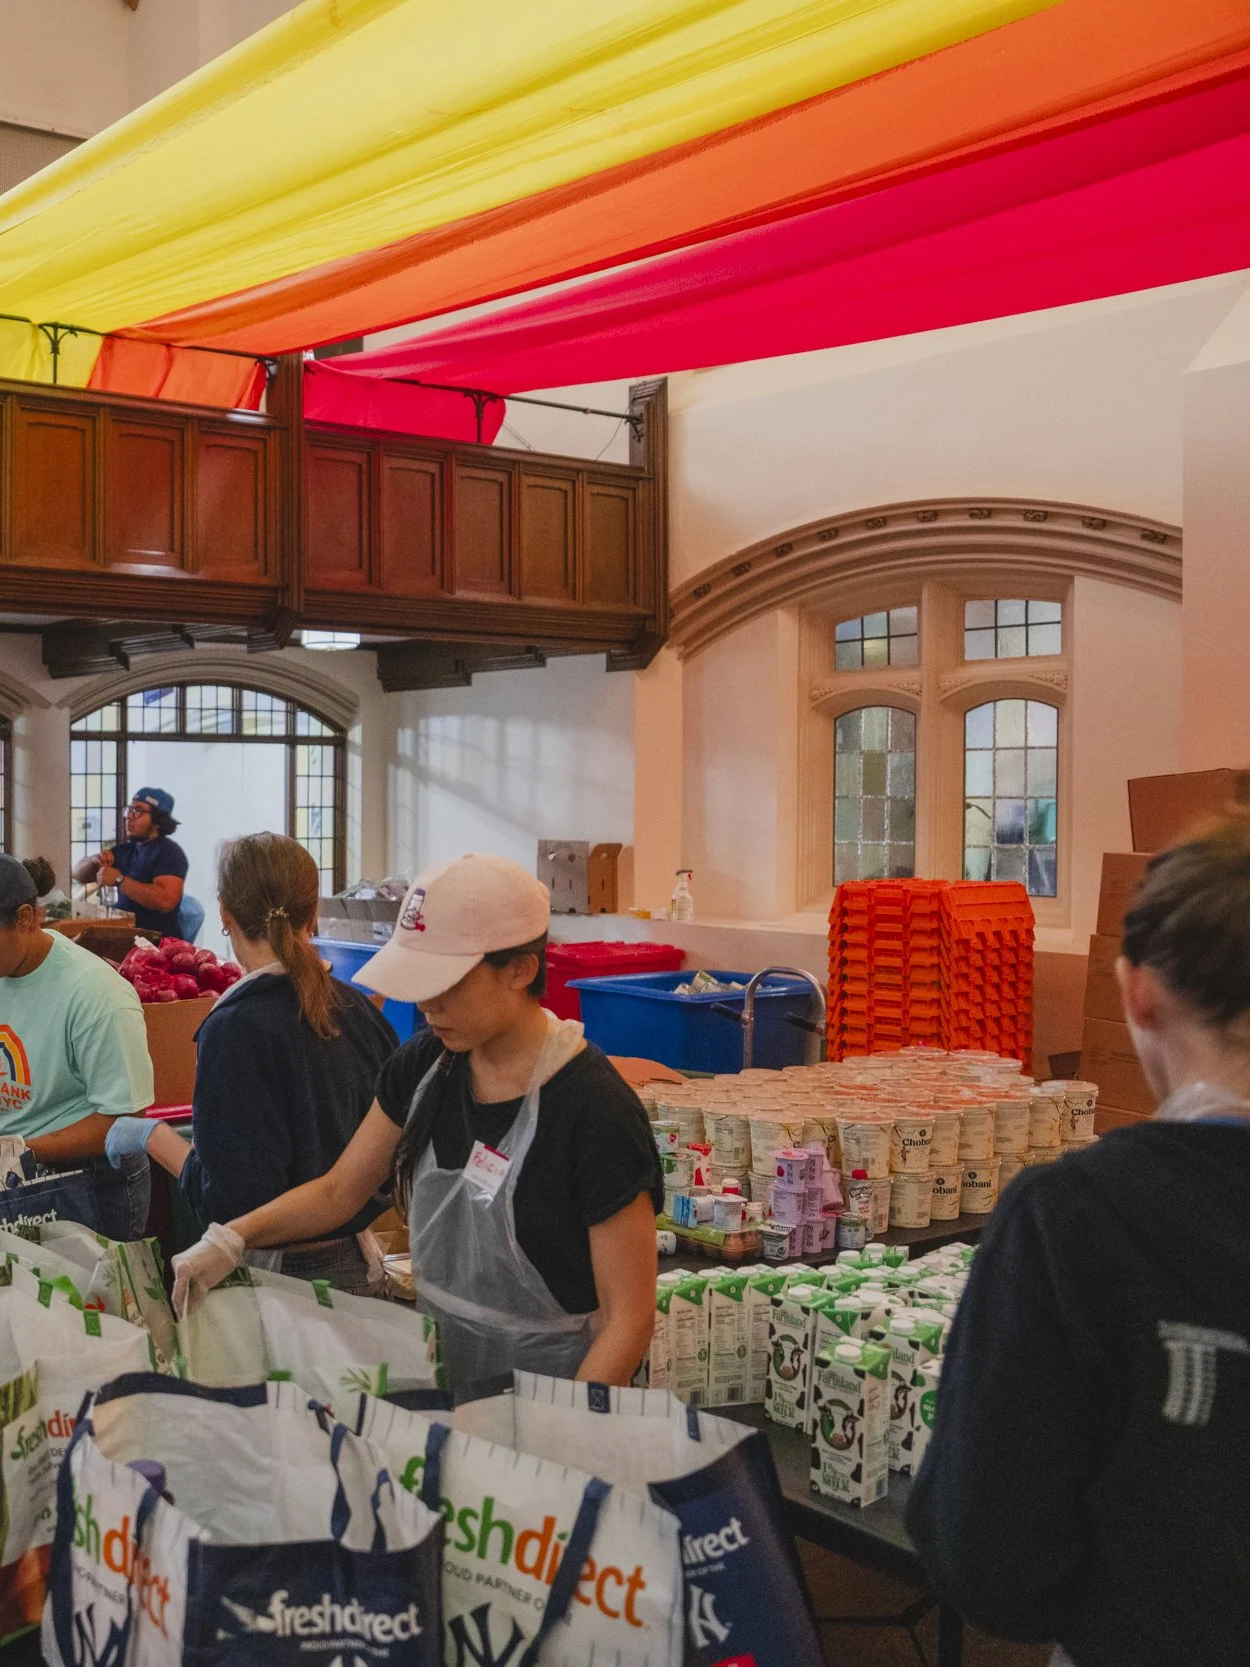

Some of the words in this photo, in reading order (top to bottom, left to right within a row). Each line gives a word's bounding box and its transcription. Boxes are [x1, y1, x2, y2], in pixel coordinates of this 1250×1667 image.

[933, 1185, 958, 1194] obani
[961, 1180, 991, 1188] obani
[818, 1369, 861, 1394] Farmland
[400, 1456, 646, 1628] fshdiect
[683, 1517, 750, 1564] irect
[476, 1573, 538, 1606] PARTNER
